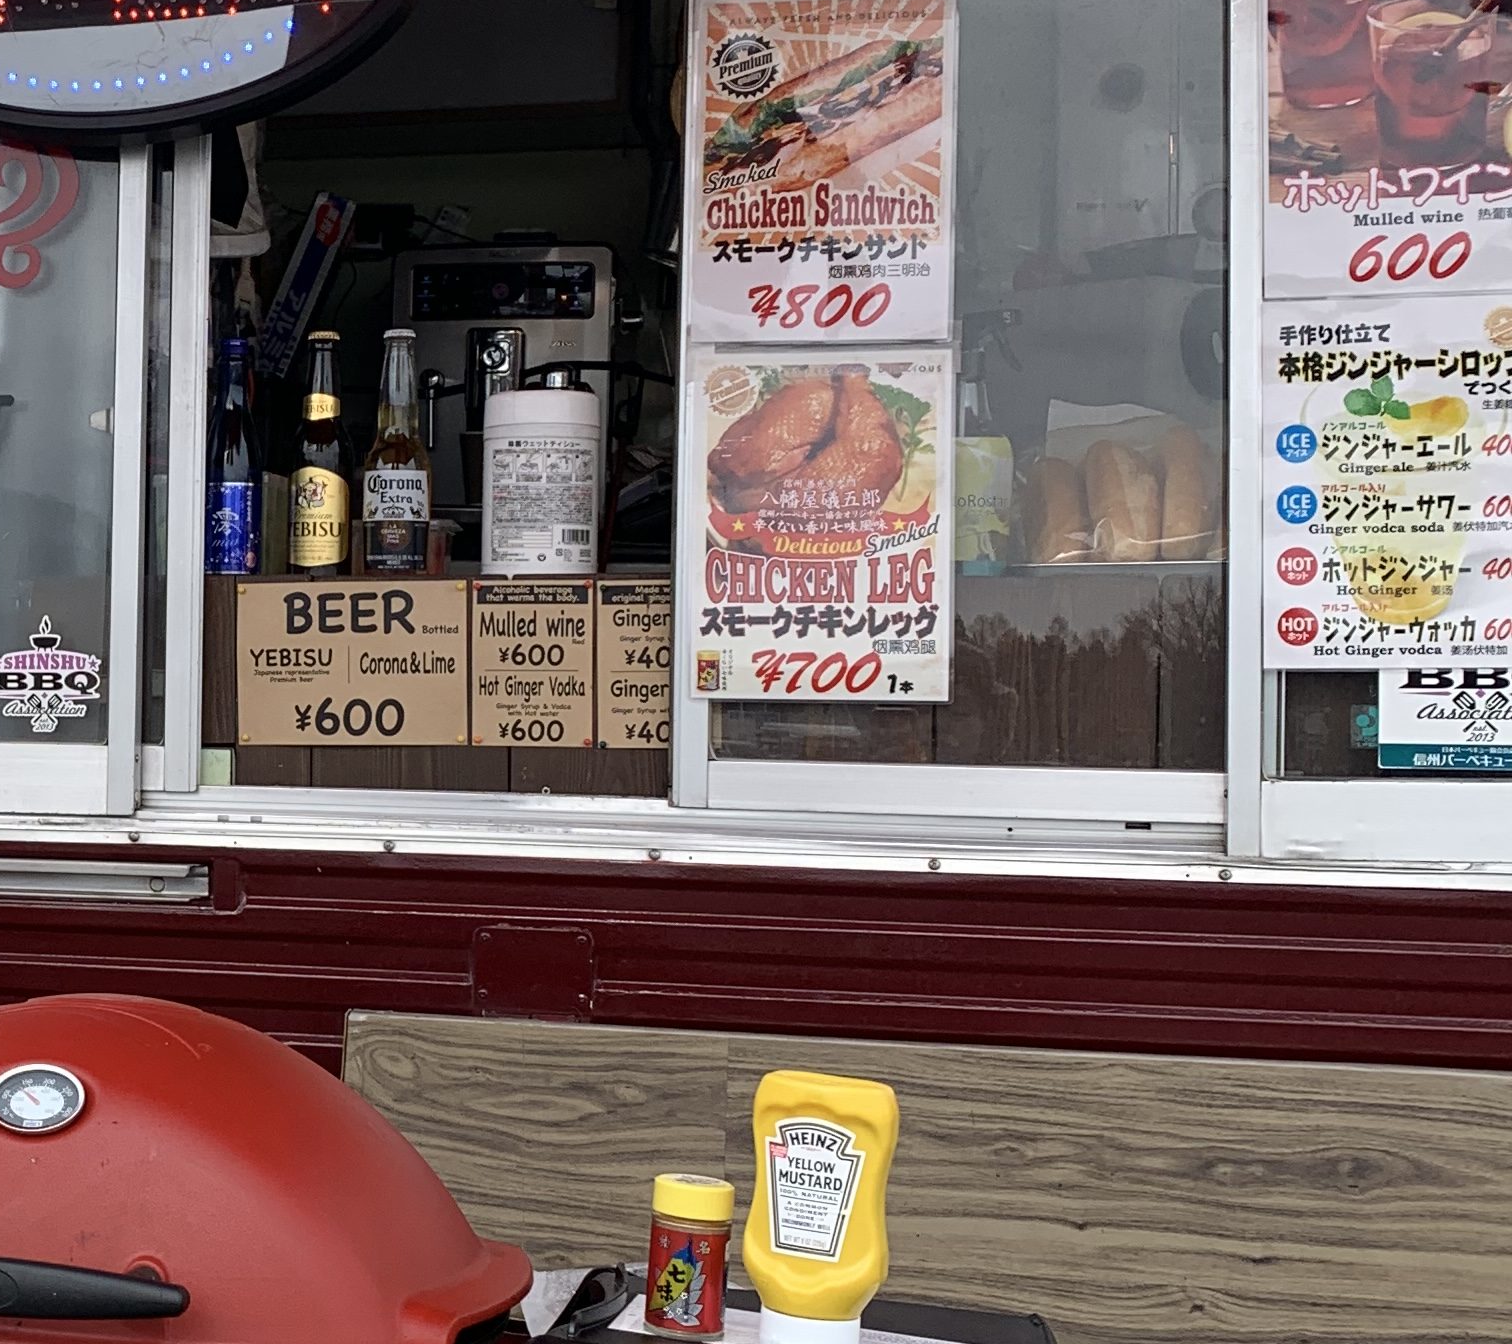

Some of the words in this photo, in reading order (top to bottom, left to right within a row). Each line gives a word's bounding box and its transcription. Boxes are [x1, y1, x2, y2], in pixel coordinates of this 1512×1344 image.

[702, 160, 780, 195] Smoked
[707, 190, 806, 232] Chicken
[815, 183, 936, 228] Sandwich
[1353, 212, 1414, 227] Mulled
[1421, 210, 1464, 224] wine
[712, 234, 927, 264] スモークチキンサンド
[1349, 231, 1472, 283] 600
[748, 282, 891, 329] ¥800
[1279, 323, 1390, 347] 手作り仕立て
[1338, 462, 1390, 476] Ginger
[1394, 463, 1414, 473] ale
[368, 474, 425, 495] Corona
[380, 492, 412, 504] Extra
[773, 535, 862, 556] Delicious
[864, 514, 939, 558] Smoked
[1309, 523, 1358, 537] Ginger
[1362, 522, 1406, 535] vodca
[1411, 521, 1444, 533] soda
[706, 548, 858, 604] CHICKEN
[867, 547, 936, 604] LEG
[1336, 584, 1367, 596] Hot
[1370, 584, 1418, 598] Ginger
[283, 589, 416, 635] BEER
[422, 624, 459, 634] Bottled
[479, 610, 537, 638] Mulled
[546, 610, 585, 638] wine
[613, 609, 671, 633] Ginger
[699, 604, 940, 638] スモークチキンレッグ
[4, 654, 86, 670] SHINSHU
[250, 648, 333, 667] YEBISU
[360, 650, 456, 675] Corona&Lime
[499, 643, 564, 666] ¥600
[1314, 646, 1340, 656] Hot
[1345, 645, 1394, 658] Ginger
[1400, 645, 1442, 655] vodca
[479, 676, 499, 696] Hot
[505, 675, 544, 702] Ginger
[549, 675, 585, 696] Vodka
[610, 679, 670, 703] Ginger
[295, 697, 405, 737] ¥600
[499, 719, 564, 742] ¥600
[789, 1132, 837, 1152] HEINZ
[787, 1157, 836, 1174] YELLOW
[778, 1169, 843, 1191] MUSTARD
